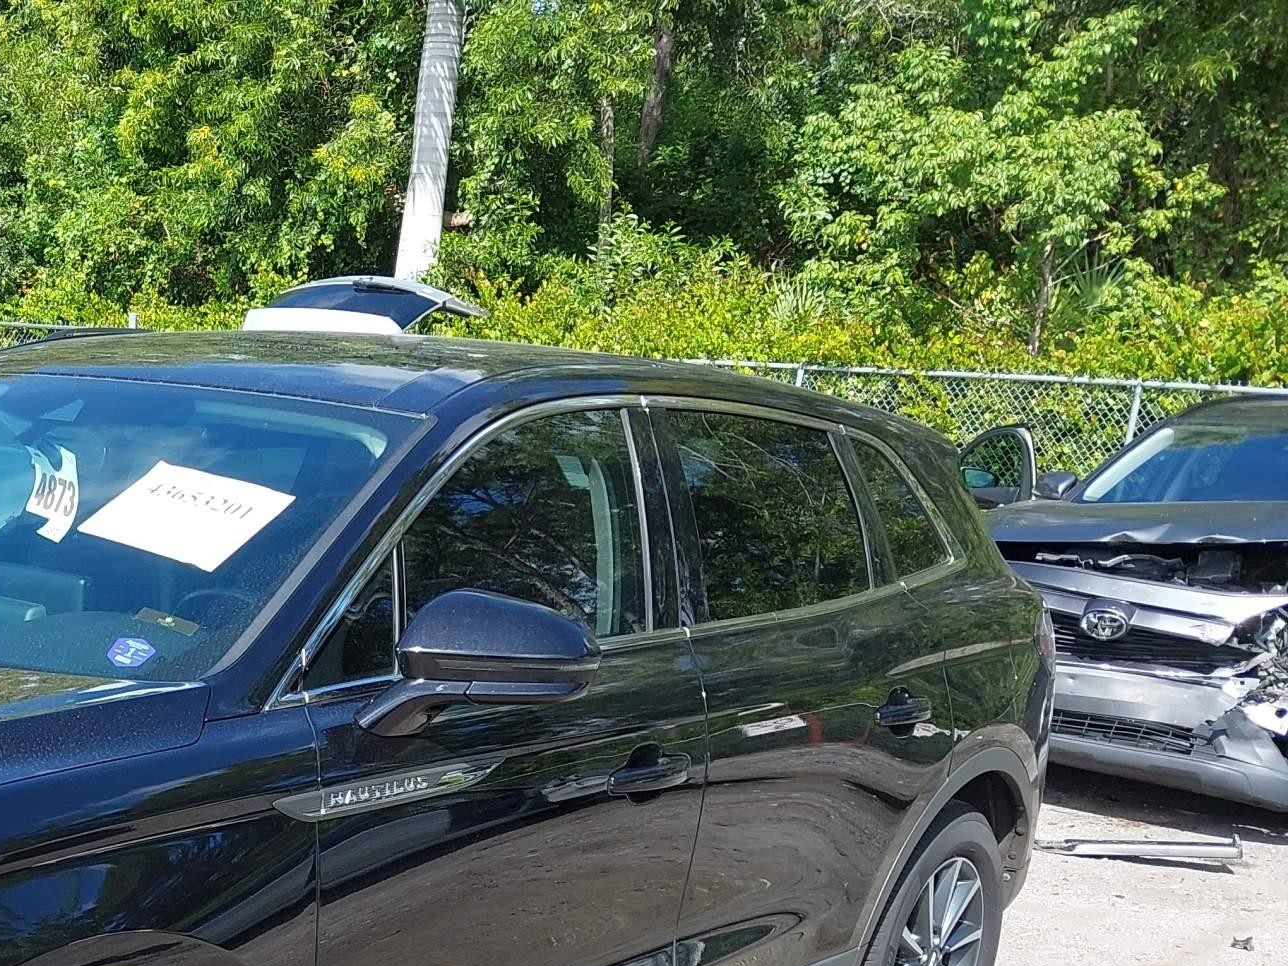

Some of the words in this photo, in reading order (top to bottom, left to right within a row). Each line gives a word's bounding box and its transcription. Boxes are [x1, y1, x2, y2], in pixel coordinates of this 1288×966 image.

[34, 472, 76, 517] 4873
[147, 483, 253, 520] 43653201
[329, 776, 429, 808] NAUTILUS
